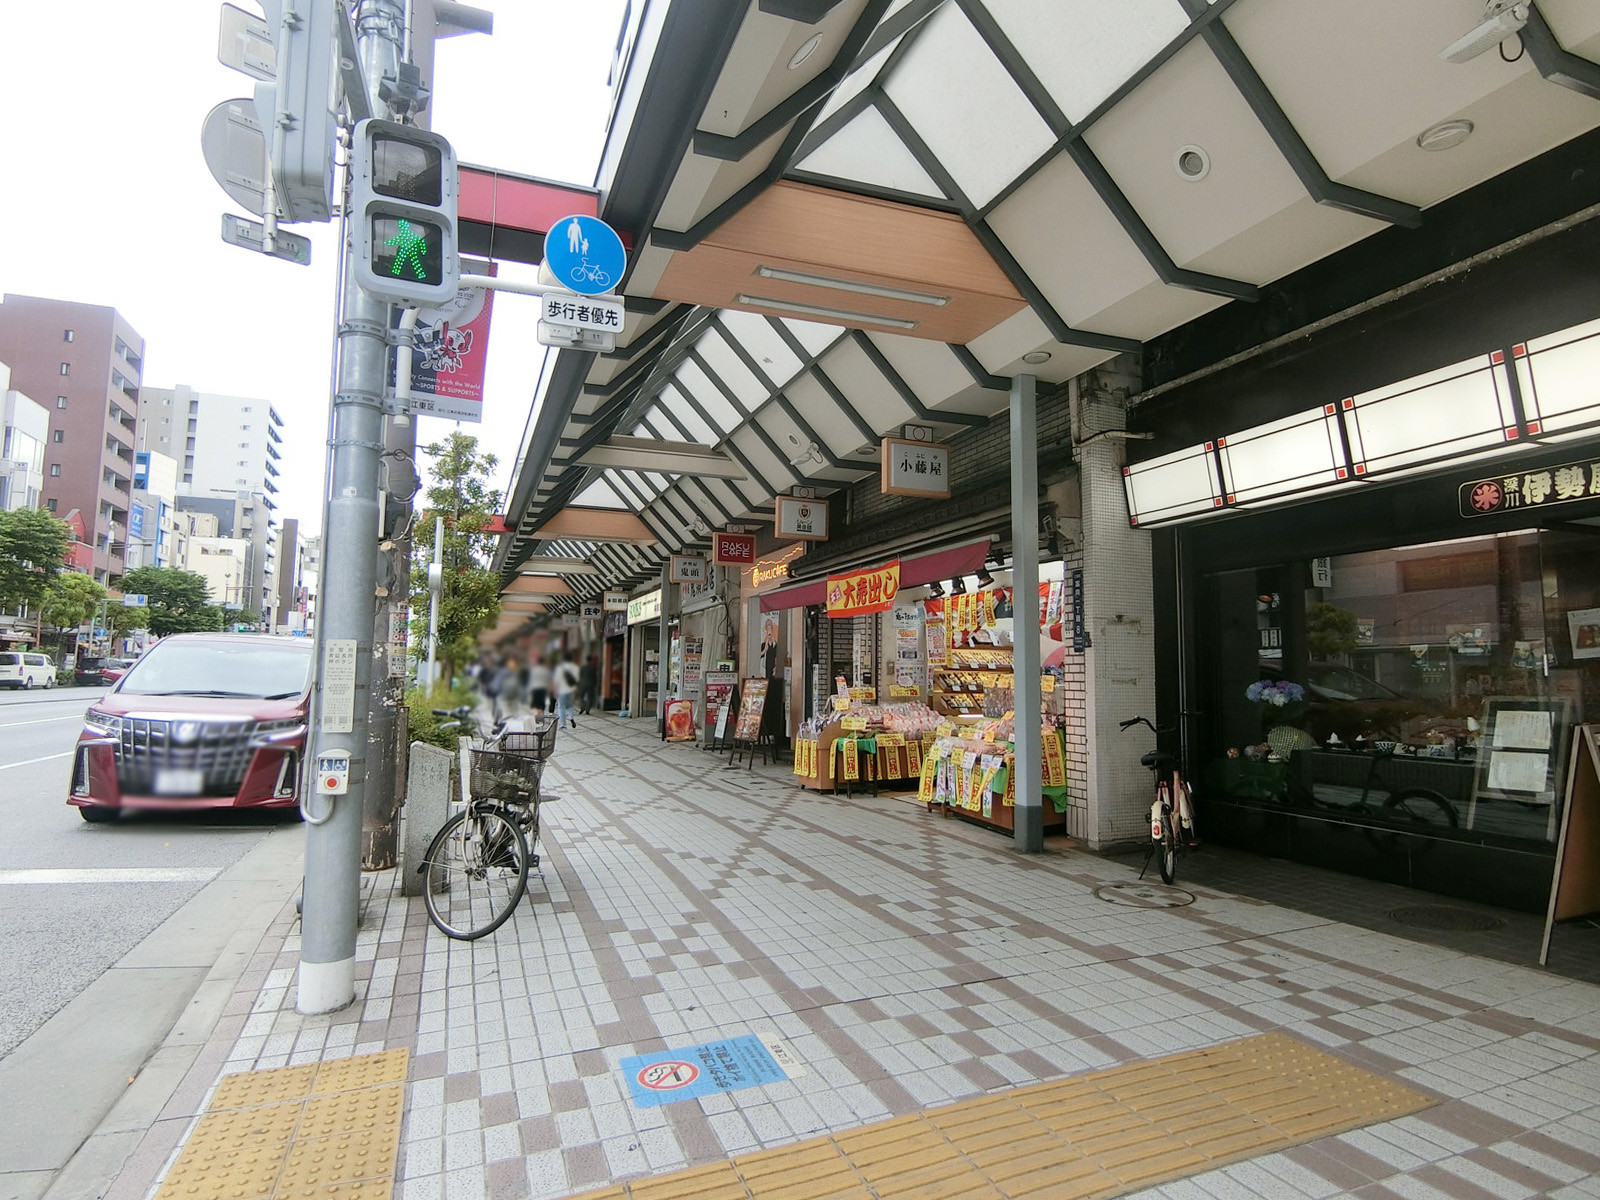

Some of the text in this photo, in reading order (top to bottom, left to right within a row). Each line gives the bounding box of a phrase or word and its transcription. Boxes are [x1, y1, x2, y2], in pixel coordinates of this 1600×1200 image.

[548, 301, 618, 326] 歩行者優先
[418, 374, 442, 384] Connects
[464, 381, 481, 391] World
[411, 400, 435, 411] 江東区
[900, 458, 942, 476] 小藤屋
[1503, 477, 1519, 508] 深川
[721, 541, 750, 550] RAKU
[721, 548, 750, 558] CAFE
[843, 571, 898, 607] 大売出し
[695, 1045, 732, 1089] 歩きタバコ禁止
[713, 1044, 746, 1083] ポイ捨て禁止
